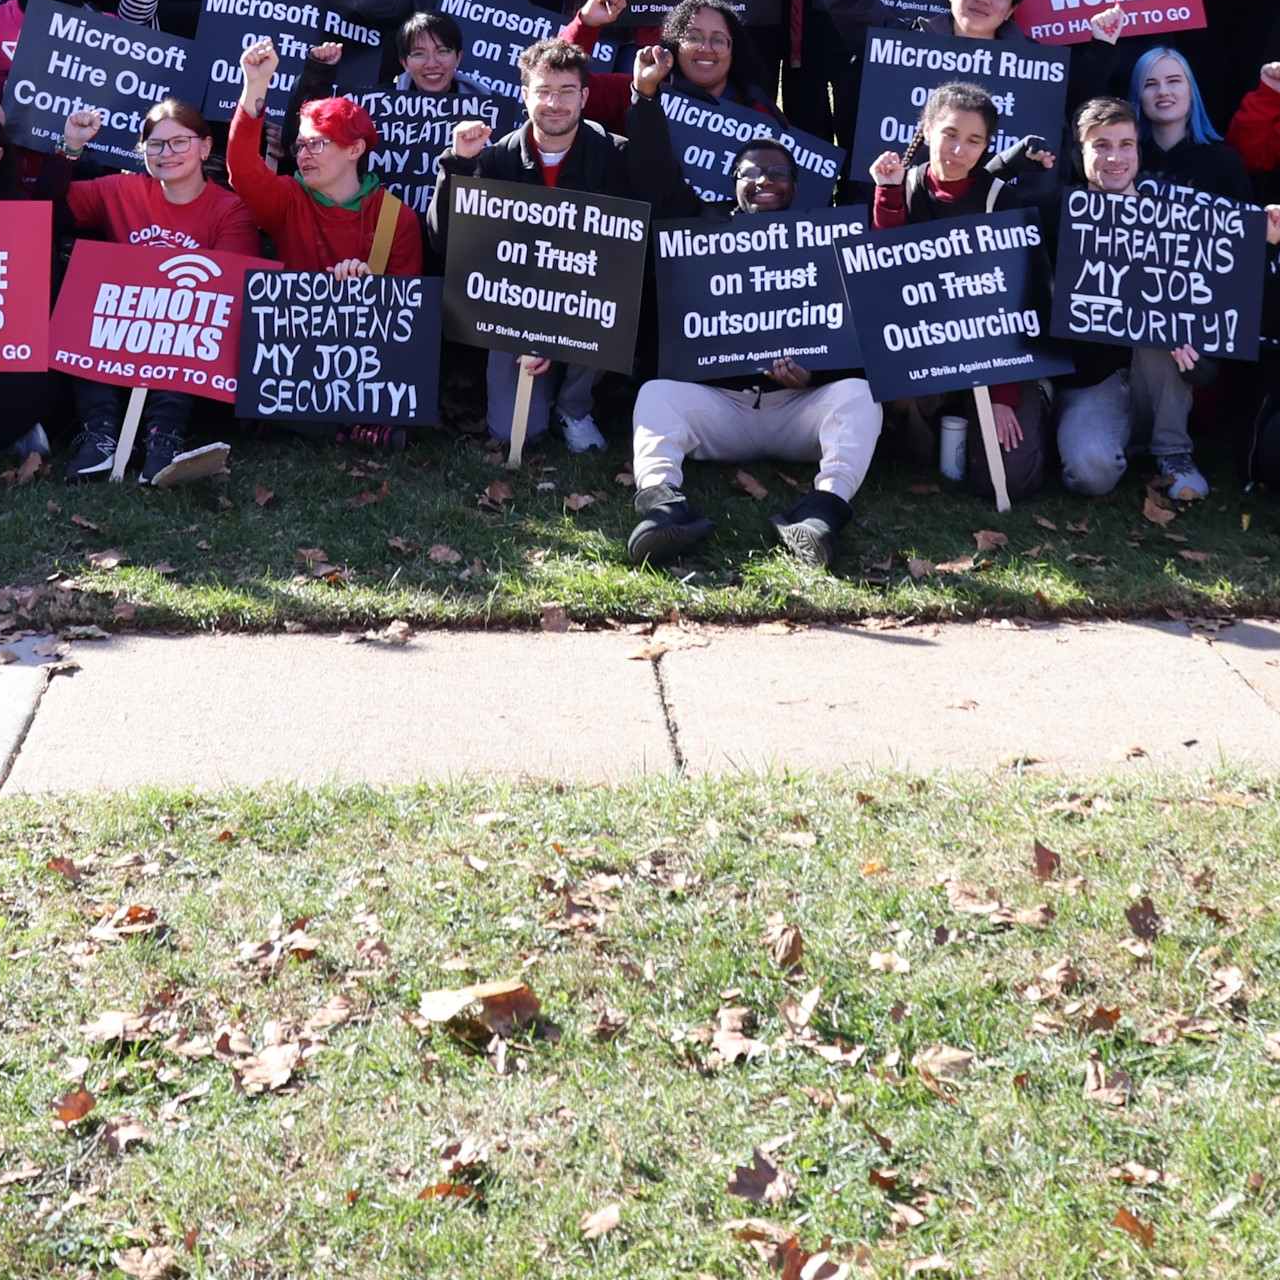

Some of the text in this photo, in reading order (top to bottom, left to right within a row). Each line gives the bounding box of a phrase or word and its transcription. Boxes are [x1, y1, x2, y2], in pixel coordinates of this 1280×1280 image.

[455, 187, 644, 241] Microsoft Runs
[1069, 190, 1245, 240] OUTSOURCING
[130, 224, 200, 249] CODE-CW
[840, 225, 1040, 274] Microsoft Runs
[1072, 220, 1234, 276] THREATENS
[497, 240, 598, 276] on Trust
[248, 271, 422, 309] OUTSOURCING
[467, 272, 616, 330] Outsourcing
[902, 266, 1007, 306] on Trust
[1074, 259, 1212, 304] MY JOB
[251, 305, 413, 342] THREATENS
[476, 321, 598, 351] ULP Strike Against Microsoft
[883, 307, 1040, 351] Outsourcing
[1069, 299, 1238, 355] SECURITY!
[2, 344, 31, 360] GO
[252, 343, 381, 382] MY JOB
[258, 378, 417, 417] SECURITY!
